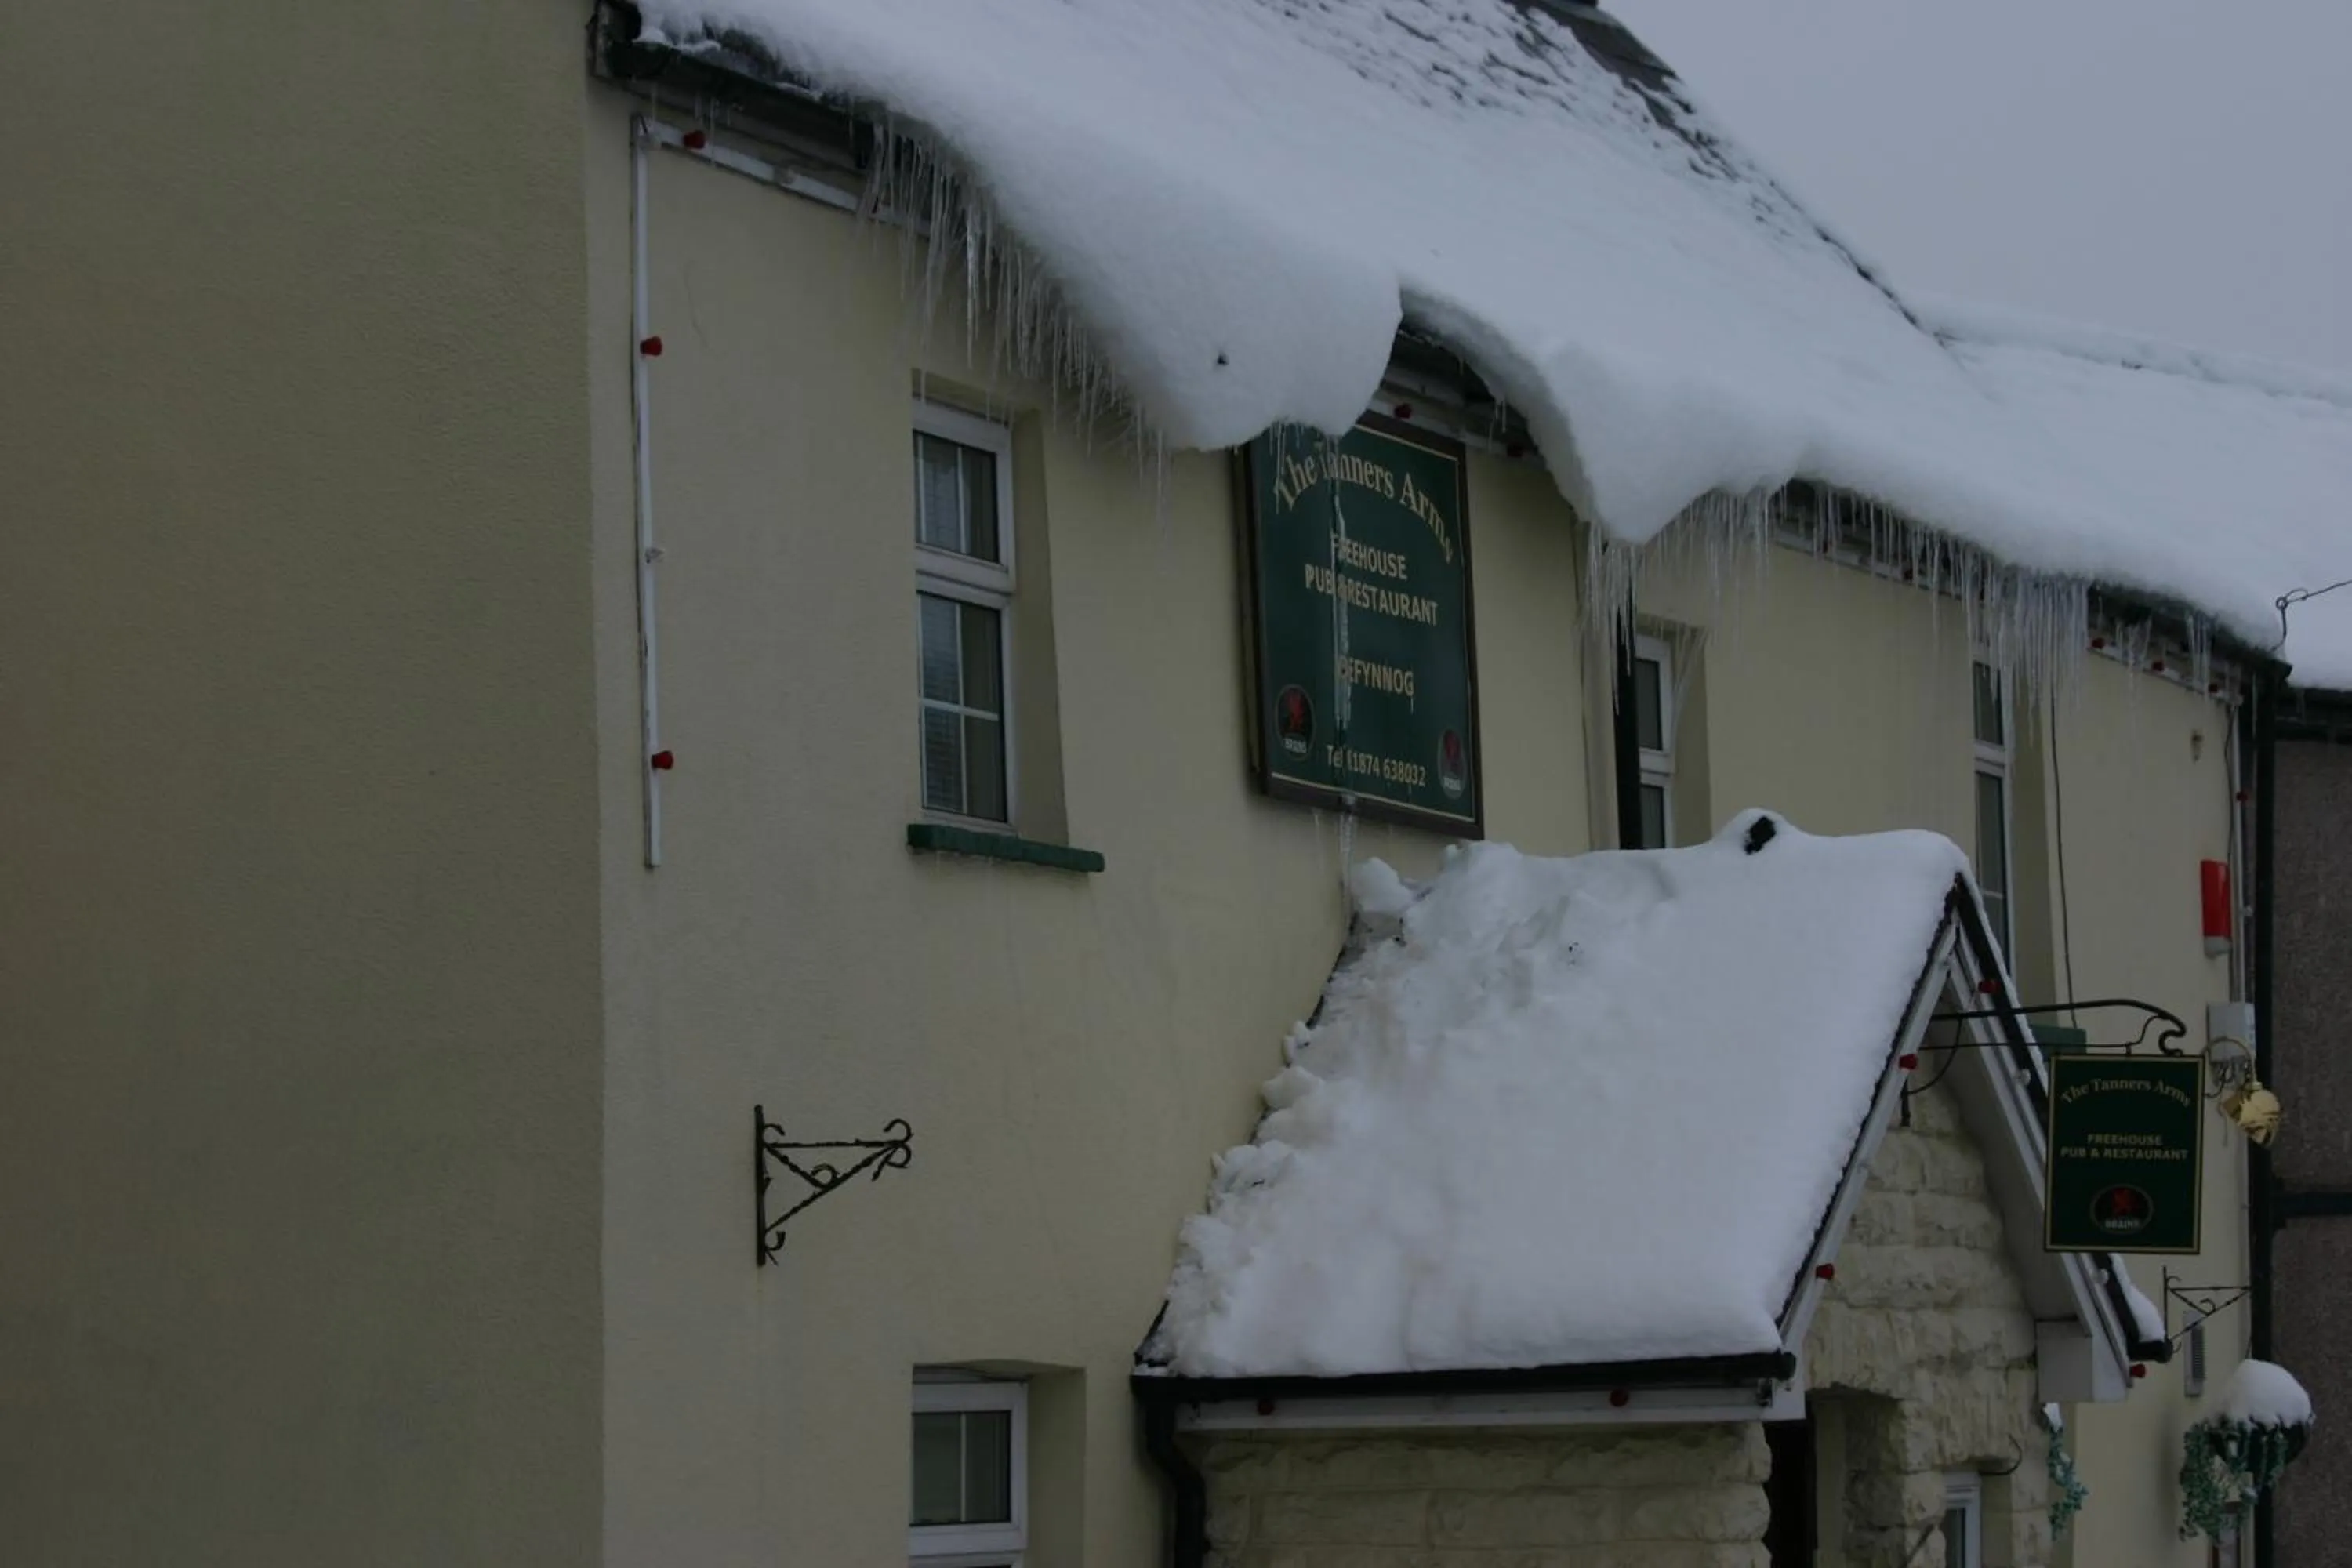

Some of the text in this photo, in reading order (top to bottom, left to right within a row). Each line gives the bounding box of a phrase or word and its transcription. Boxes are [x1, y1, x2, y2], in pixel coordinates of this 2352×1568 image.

[1272, 454, 1319, 510] The
[1399, 472, 1454, 564] Arms
[1305, 564, 1335, 595] PUB
[1348, 578, 1439, 626] RESTAURANT
[1327, 745, 1343, 768] Tel
[1383, 757, 1426, 788] 638032
[2060, 1078, 2191, 1109] The Tanners Arms
[2060, 1146, 2190, 1161] PUB & RESTAURANT
[2087, 1133, 2164, 1145] FREEHOUSE
